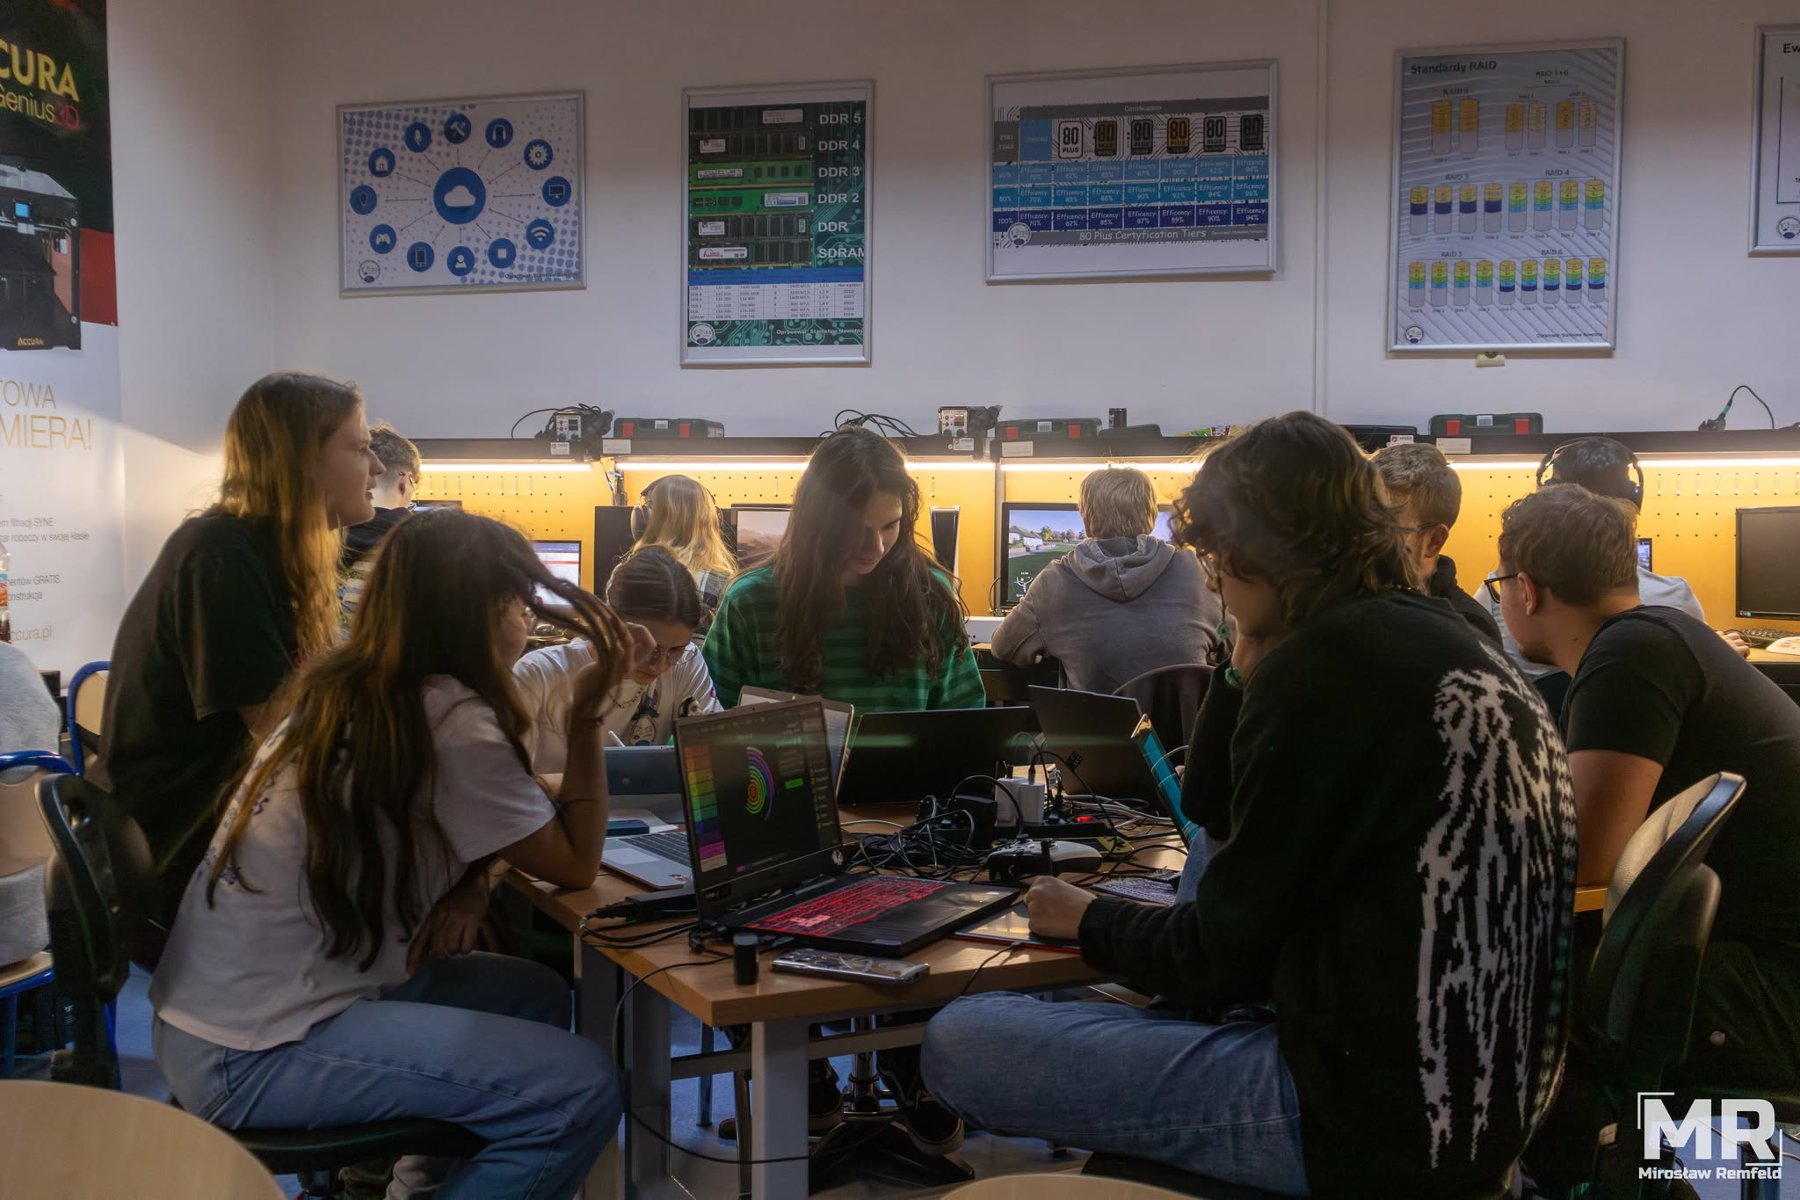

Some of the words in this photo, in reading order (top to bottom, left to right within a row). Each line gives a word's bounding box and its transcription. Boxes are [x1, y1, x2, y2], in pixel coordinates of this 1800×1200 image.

[1410, 61, 1466, 74] Standardy
[1469, 60, 1497, 71] RAID
[819, 113, 849, 125] DDR
[853, 112, 861, 123] 5
[1170, 120, 1187, 139] 80
[1206, 119, 1223, 137] 80
[1063, 127, 1079, 145] 80
[818, 140, 848, 152] DDR
[852, 139, 860, 150] 4
[818, 166, 848, 178] DDR
[852, 165, 861, 176] 3
[818, 193, 848, 204] DDR
[851, 192, 860, 203] 2
[818, 221, 847, 232] DDR
[1080, 231, 1092, 241] 80
[1094, 231, 1113, 240] Plus
[1115, 230, 1178, 242] Certyfication
[1182, 229, 1207, 238] Tiers
[818, 247, 864, 259] SDRAM
[0, 379, 57, 409] OWA
[0, 413, 92, 451] MIERA!
[33, 574, 60, 585] GRATIS
